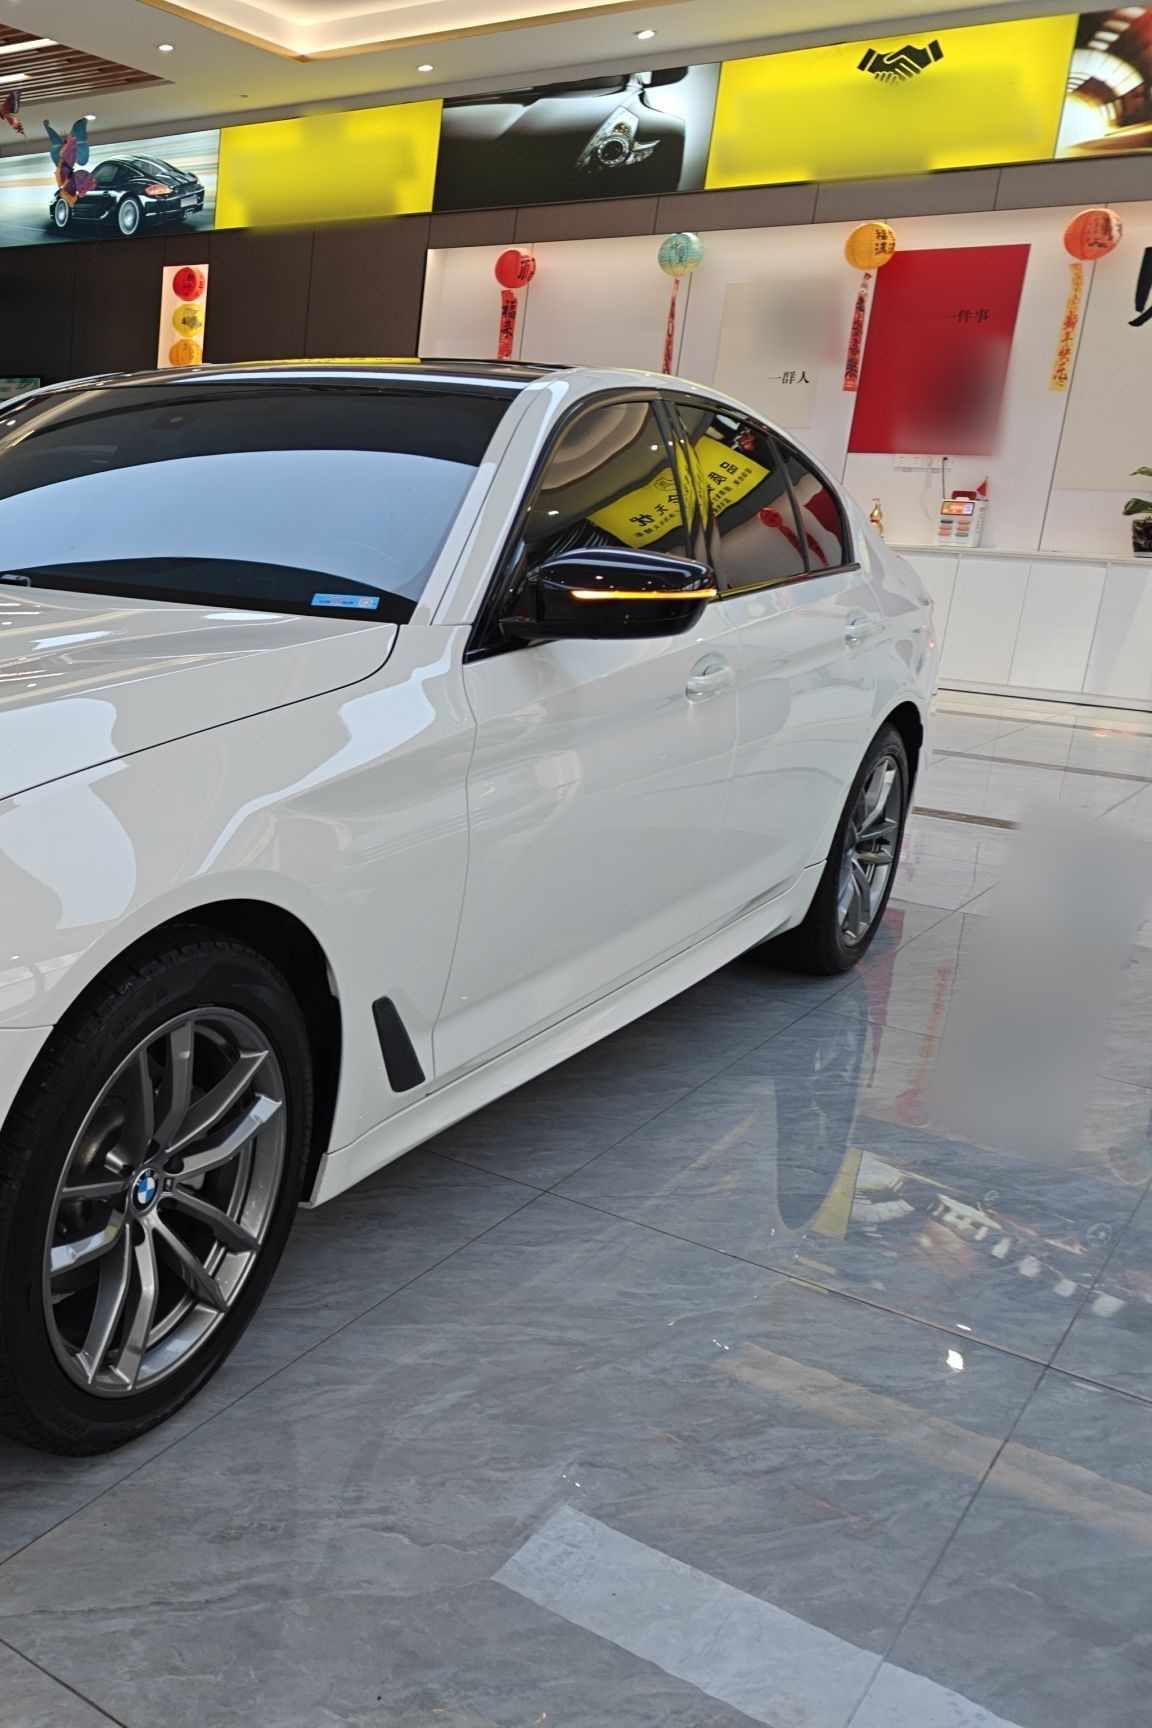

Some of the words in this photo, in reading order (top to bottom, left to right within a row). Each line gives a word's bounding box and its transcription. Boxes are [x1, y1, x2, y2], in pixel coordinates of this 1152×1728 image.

[939, 308, 991, 324] 一件事
[767, 370, 810, 385] 一群人
